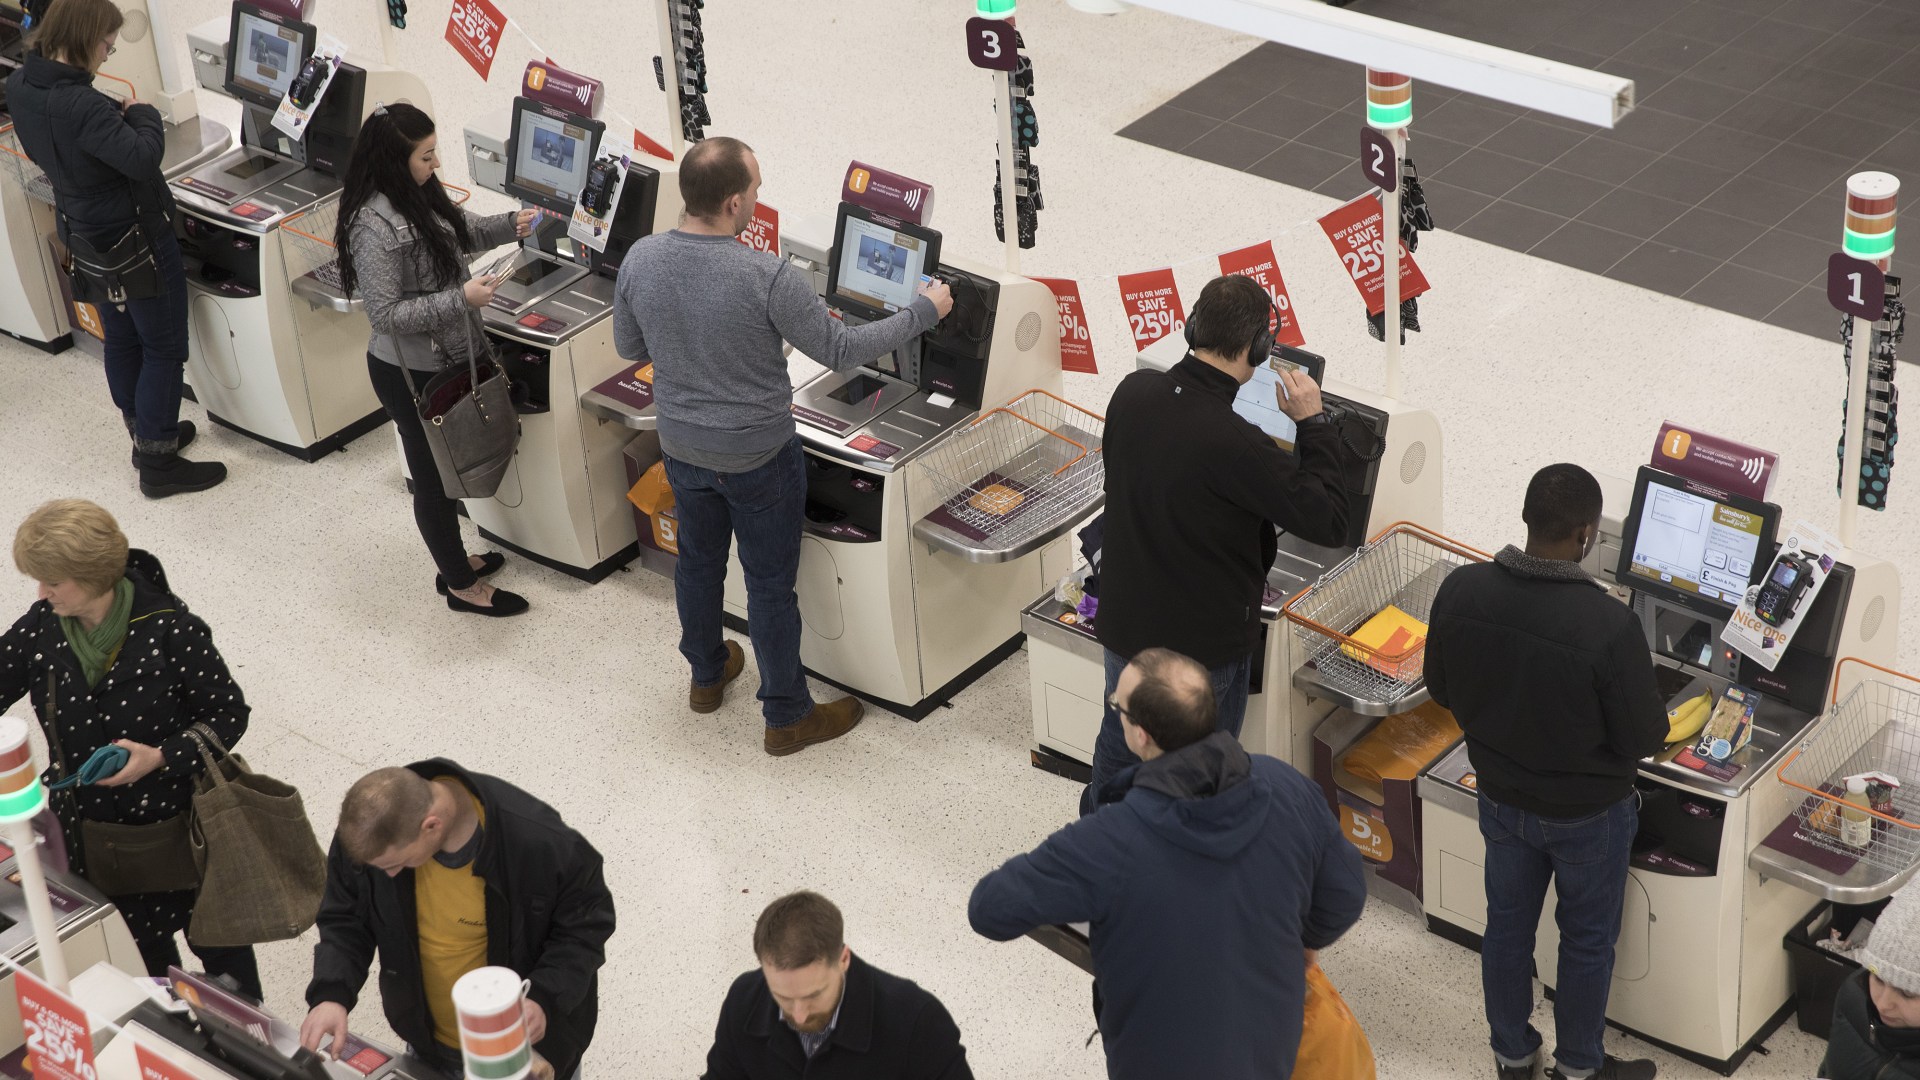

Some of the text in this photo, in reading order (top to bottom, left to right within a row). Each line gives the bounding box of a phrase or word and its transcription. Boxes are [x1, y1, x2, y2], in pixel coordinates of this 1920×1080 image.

[452, 2, 494, 58] 25%
[466, 4, 490, 32] SAVE
[484, 14, 498, 32] MORE
[981, 30, 1001, 58] 3
[280, 102, 308, 122] Nice one
[1371, 143, 1384, 177] 2
[574, 210, 592, 226] Nice
[594, 219, 608, 230] one
[746, 222, 765, 237] AVE
[757, 218, 774, 230] MORE
[1333, 213, 1382, 240] BUY 6 OR MORE
[740, 230, 776, 254] 5%
[1347, 225, 1380, 249] SAVE
[1246, 267, 1254, 275] OR
[1255, 261, 1273, 272] MORE
[1125, 292, 1138, 301] BUY
[1154, 287, 1173, 296] MORE
[1847, 272, 1865, 305] 1
[1137, 297, 1168, 313] SAVE
[1129, 309, 1185, 340] 25%
[618, 380, 649, 397] basket here
[631, 379, 647, 390] Place
[1720, 507, 1751, 522] Sainsbury's
[1702, 570, 1709, 580] £
[1728, 580, 1736, 588] Pay
[1734, 608, 1762, 632] Nice
[1763, 626, 1786, 644] one
[1352, 812, 1381, 847] 5p
[1372, 848, 1382, 857] bag
[23, 996, 40, 1010] BUY
[47, 1010, 60, 1020] OR
[60, 1016, 86, 1035] MORE
[36, 1012, 76, 1044] SAVE
[24, 1019, 96, 1080] 25%
